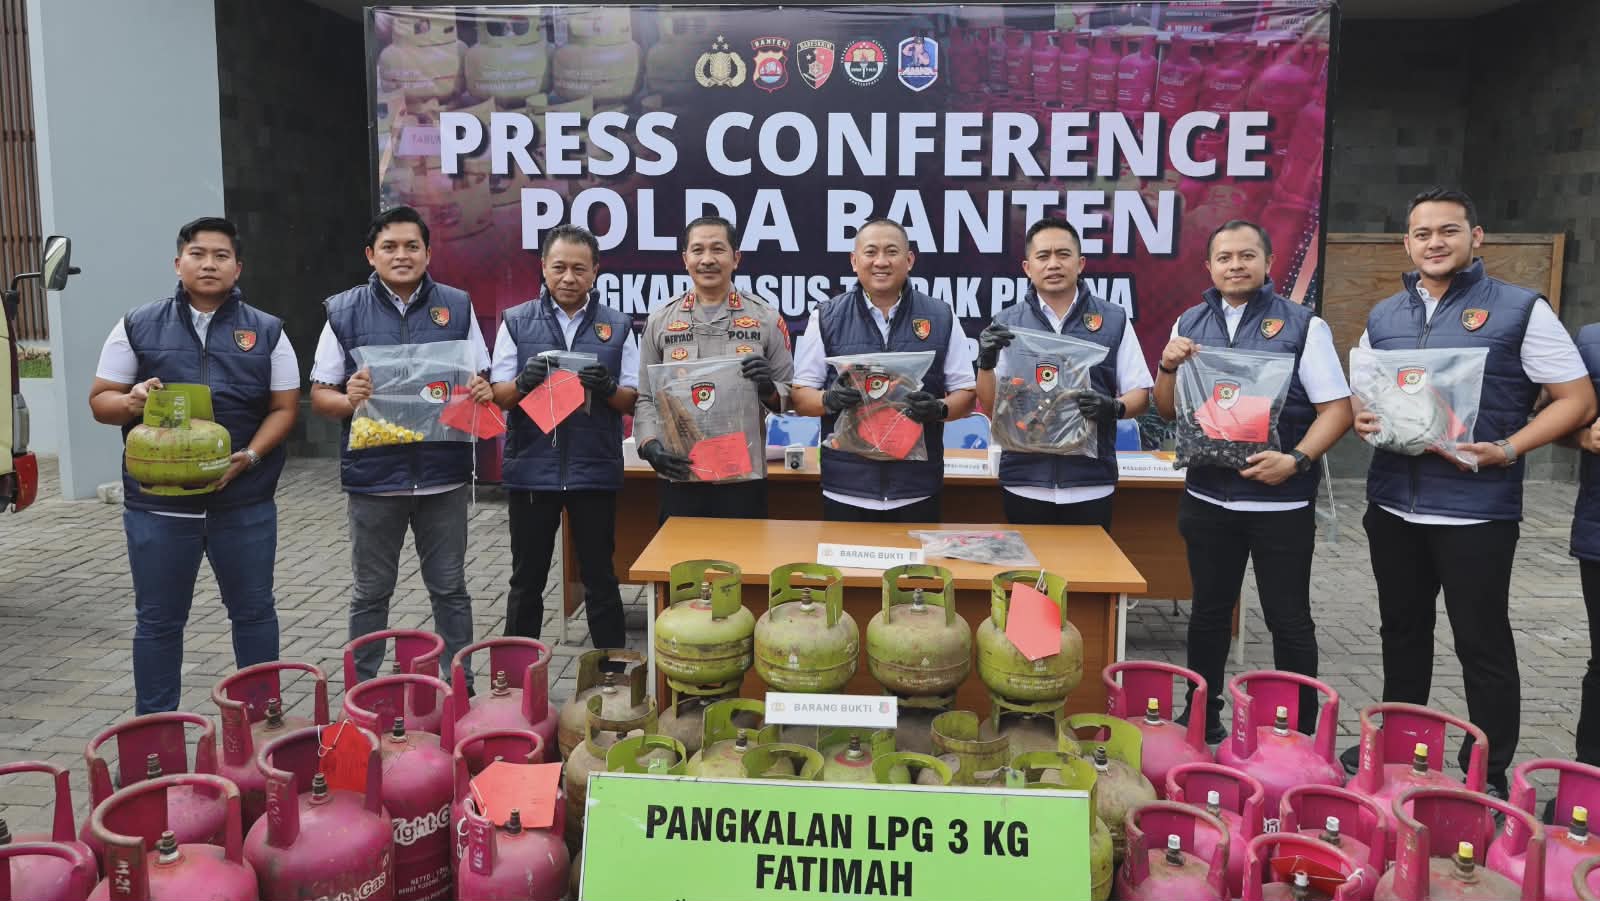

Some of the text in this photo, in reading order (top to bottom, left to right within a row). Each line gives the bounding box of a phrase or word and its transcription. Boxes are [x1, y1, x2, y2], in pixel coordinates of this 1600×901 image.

[752, 39, 788, 48] BANTEN
[439, 111, 1269, 178] PRESS CONFERENCE
[827, 189, 1175, 254] BANTEN
[732, 275, 829, 317] ASUS
[729, 330, 761, 341] POLRI
[840, 550, 904, 560] BARANG BUKTI
[794, 703, 873, 713] BARANG BUKTI
[392, 812, 438, 846] ight
[646, 805, 1029, 857] PANGKALAN LPG 3 KG
[359, 871, 386, 899] Gas
[756, 854, 913, 897] FATIMAH
